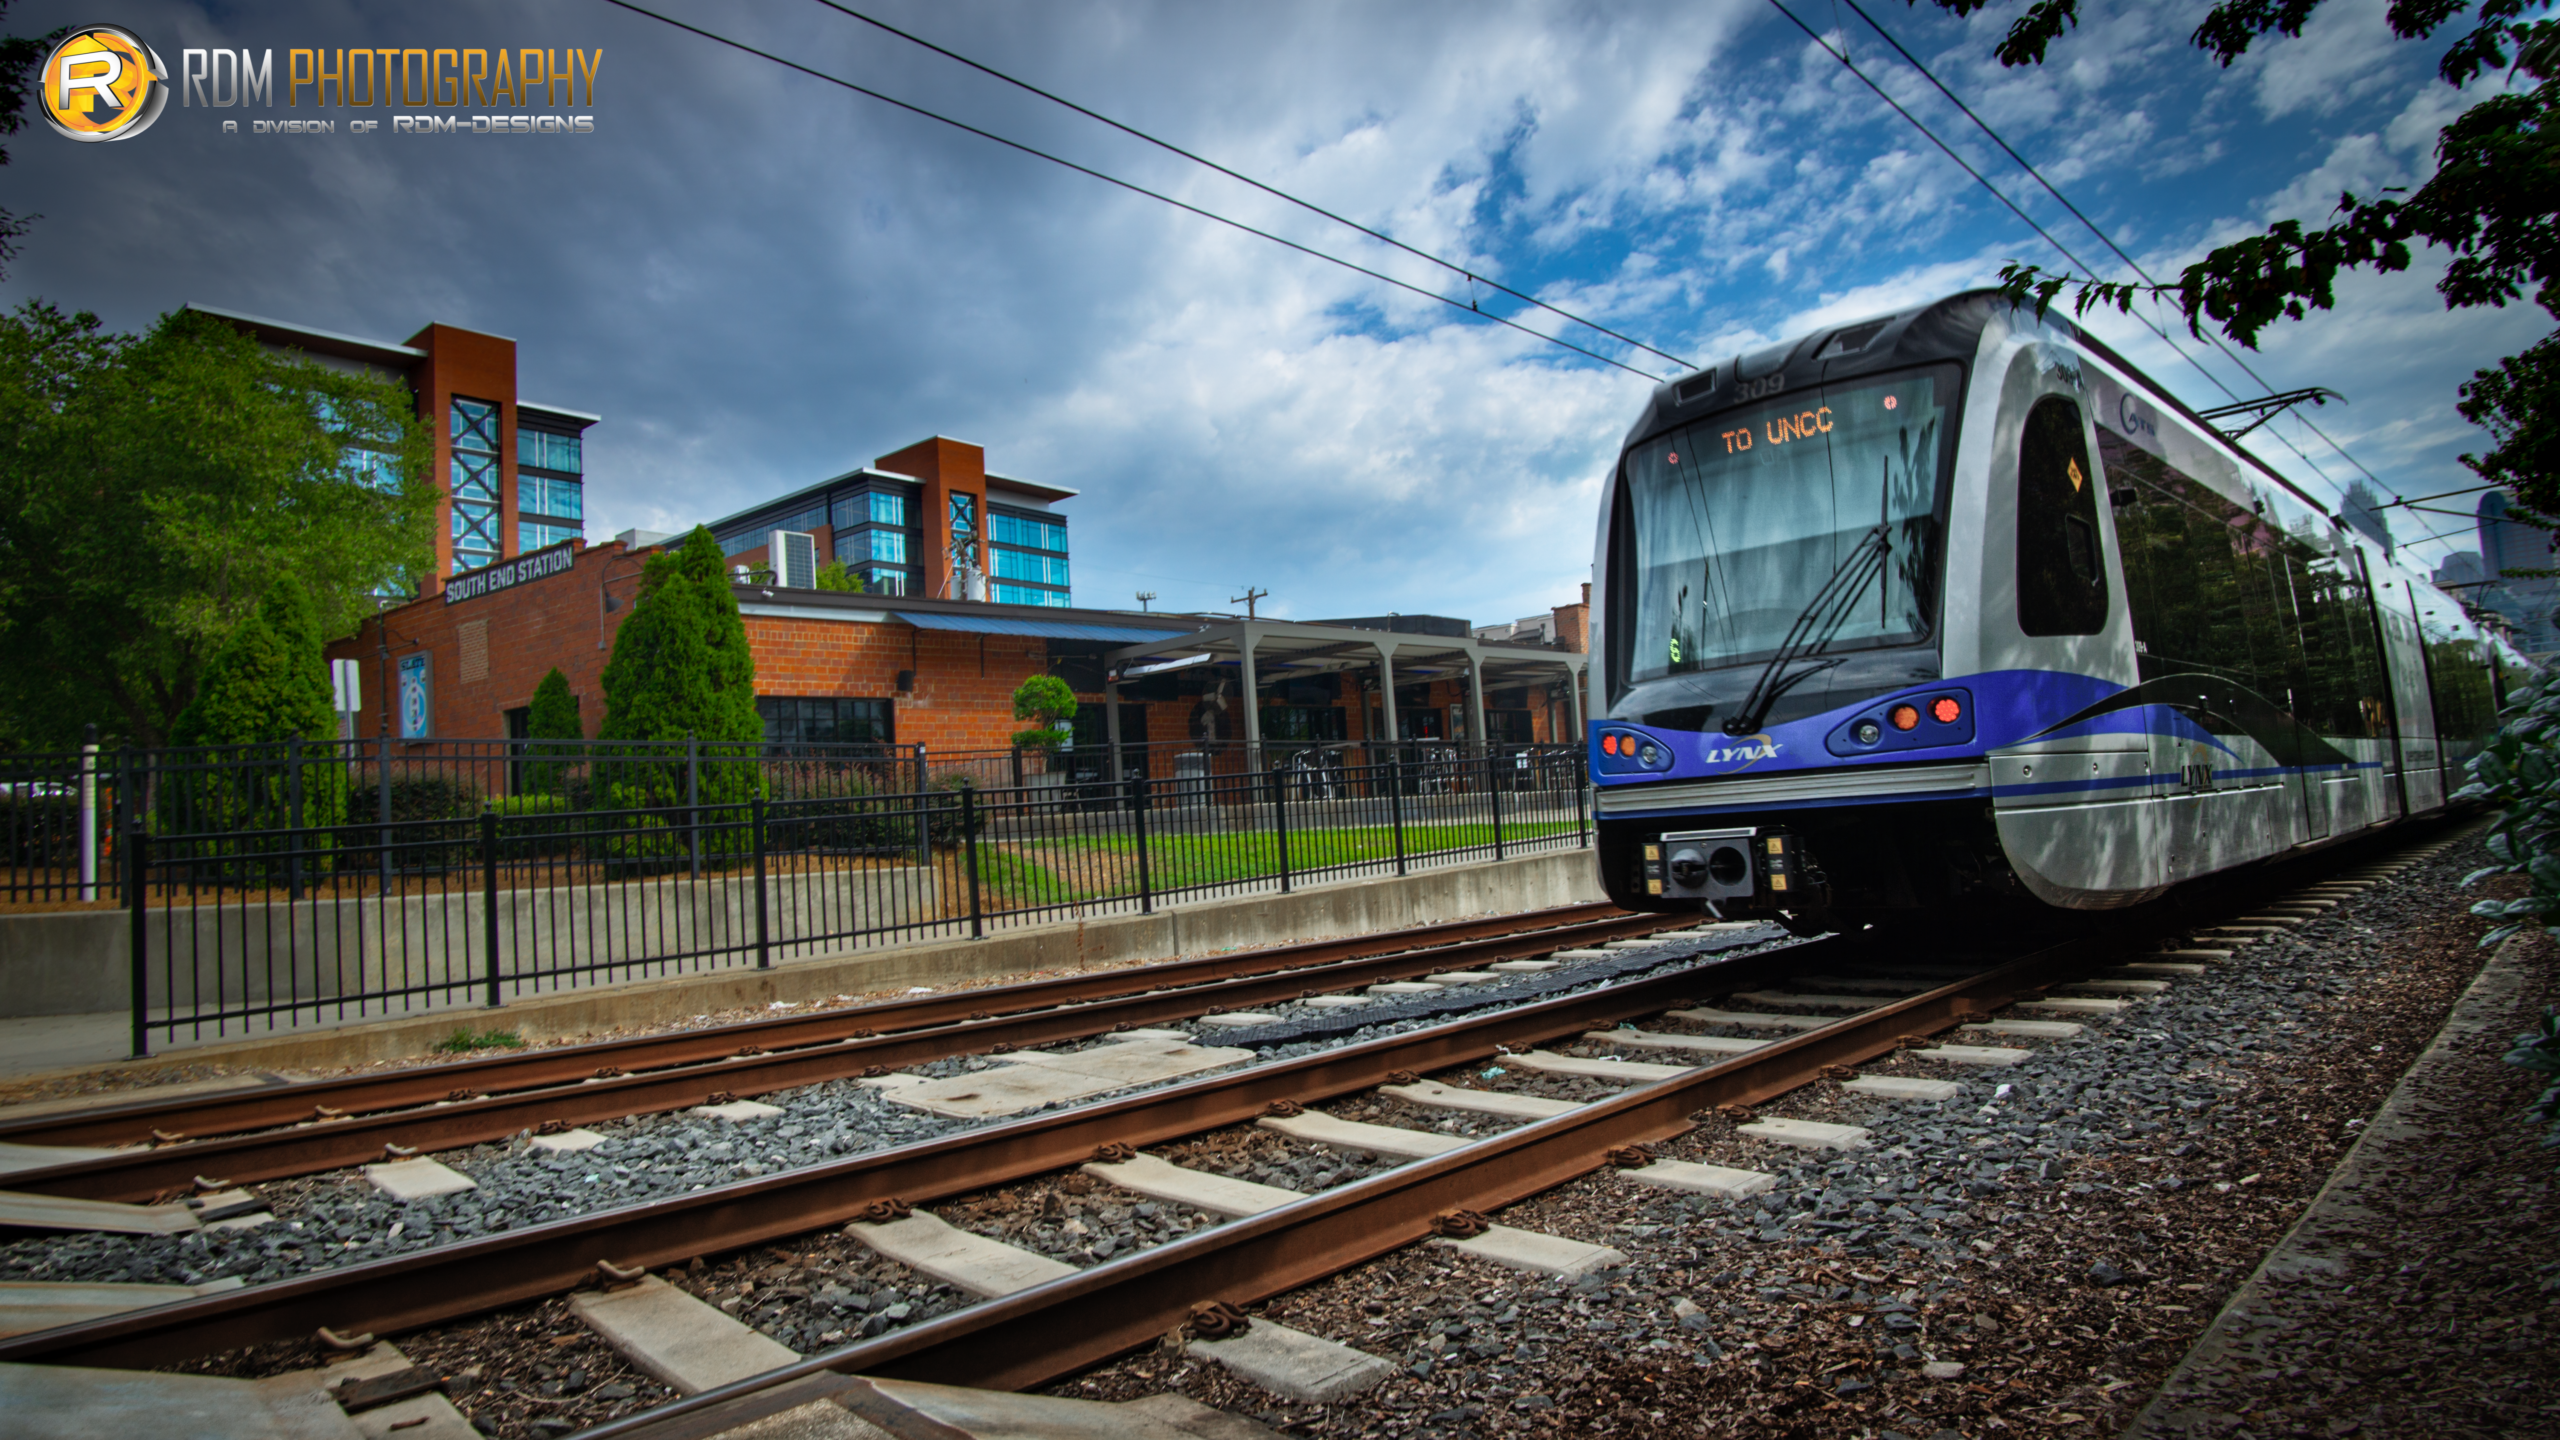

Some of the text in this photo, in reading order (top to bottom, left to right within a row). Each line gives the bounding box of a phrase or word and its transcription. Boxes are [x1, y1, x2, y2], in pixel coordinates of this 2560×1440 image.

[1733, 372, 1785, 404] 309
[1721, 406, 1834, 454] TO UNCC
[446, 546, 573, 604] SOUTH END STATION
[1705, 743, 1784, 763] LYNX
[2180, 764, 2212, 786] LYNX
